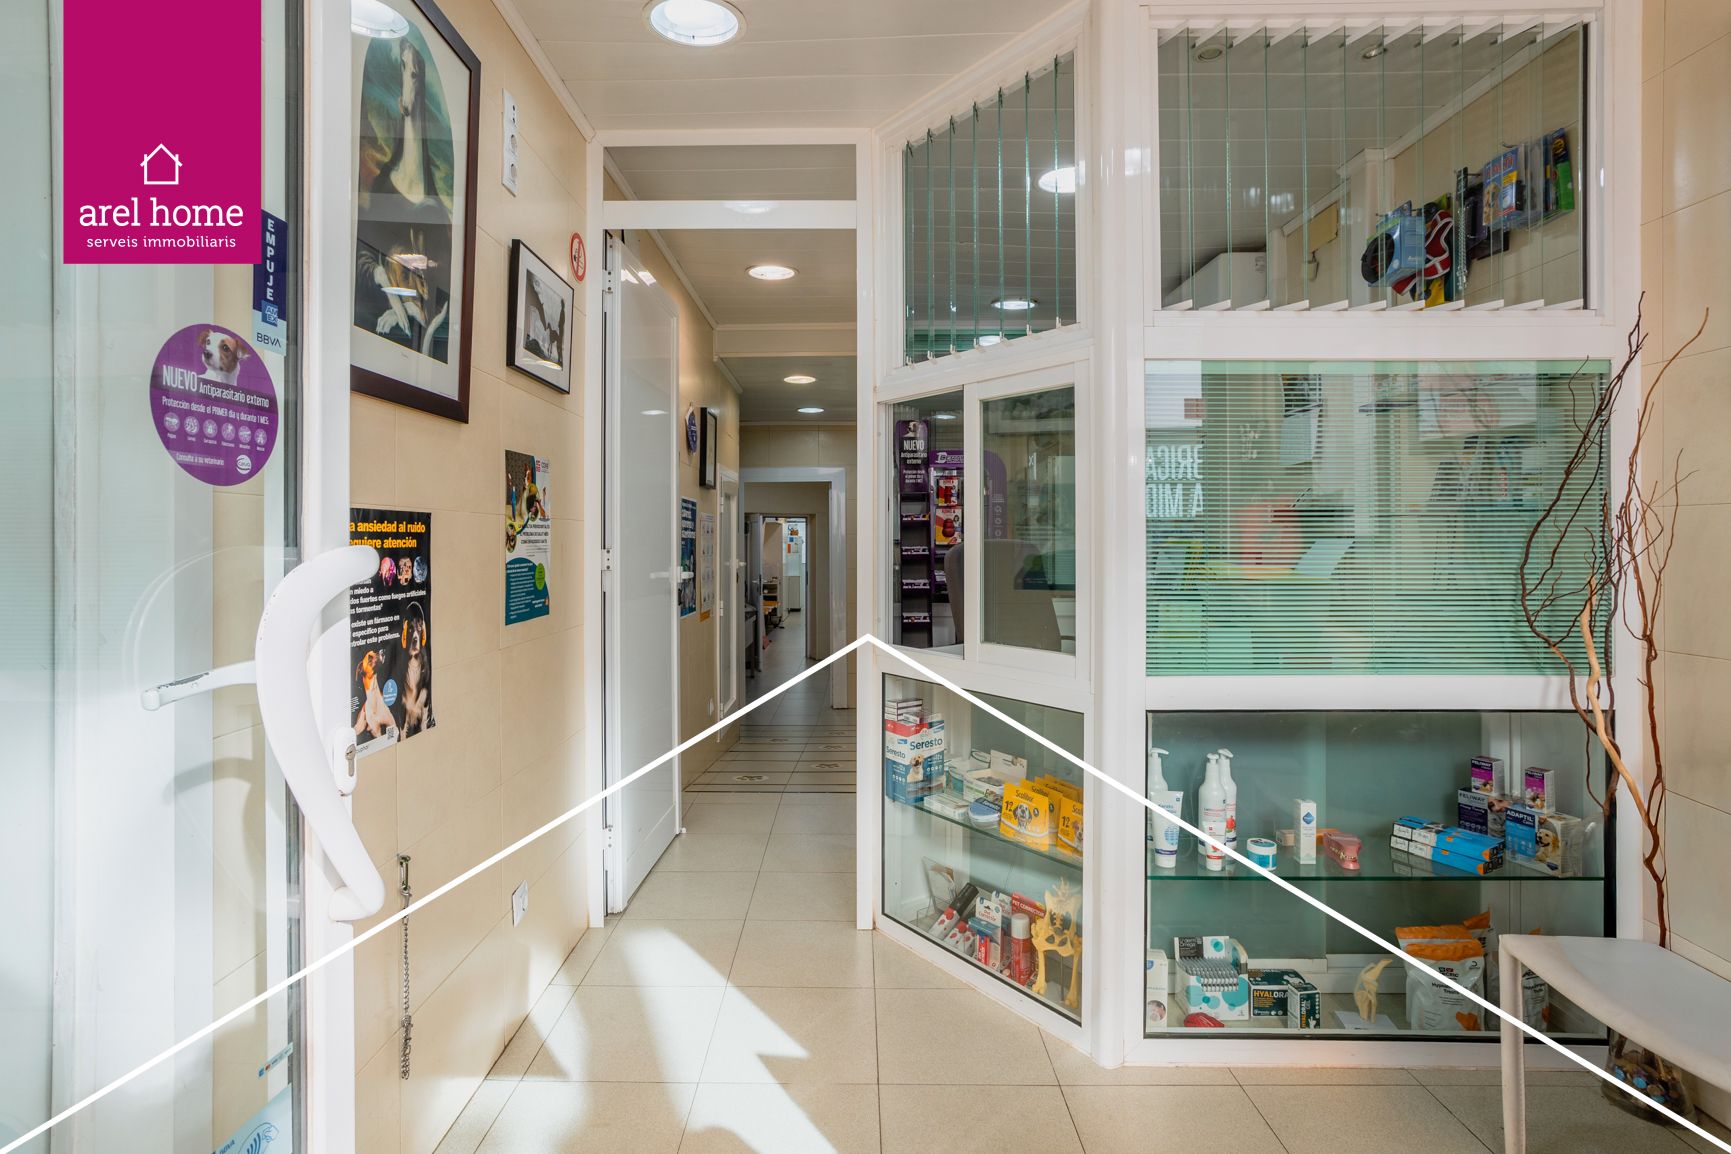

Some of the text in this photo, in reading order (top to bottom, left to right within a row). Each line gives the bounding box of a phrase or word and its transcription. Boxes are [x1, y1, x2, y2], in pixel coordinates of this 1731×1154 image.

[266, 218, 276, 301] EMPUJE
[256, 332, 281, 348] BBVA
[162, 364, 270, 408] NUEVO Antiparasitario externo
[162, 395, 191, 410] Protección
[190, 402, 206, 413] desde
[206, 405, 212, 413] el
[212, 406, 228, 416] PRIMER
[903, 440, 925, 451] NUEVO
[357, 520, 397, 532] ansiedad
[398, 522, 406, 532] al
[407, 522, 425, 533] ruido
[383, 536, 417, 548] atención
[354, 587, 369, 595] miedo
[360, 595, 378, 603] fuertes
[378, 626, 389, 634] para
[909, 737, 943, 752] Seresto
[886, 745, 906, 759] Seresto
[1459, 792, 1486, 803] FELIWAY
[1005, 800, 1014, 812] 12
[1061, 815, 1070, 828] 12
[1506, 809, 1534, 822] ADAPTIL
